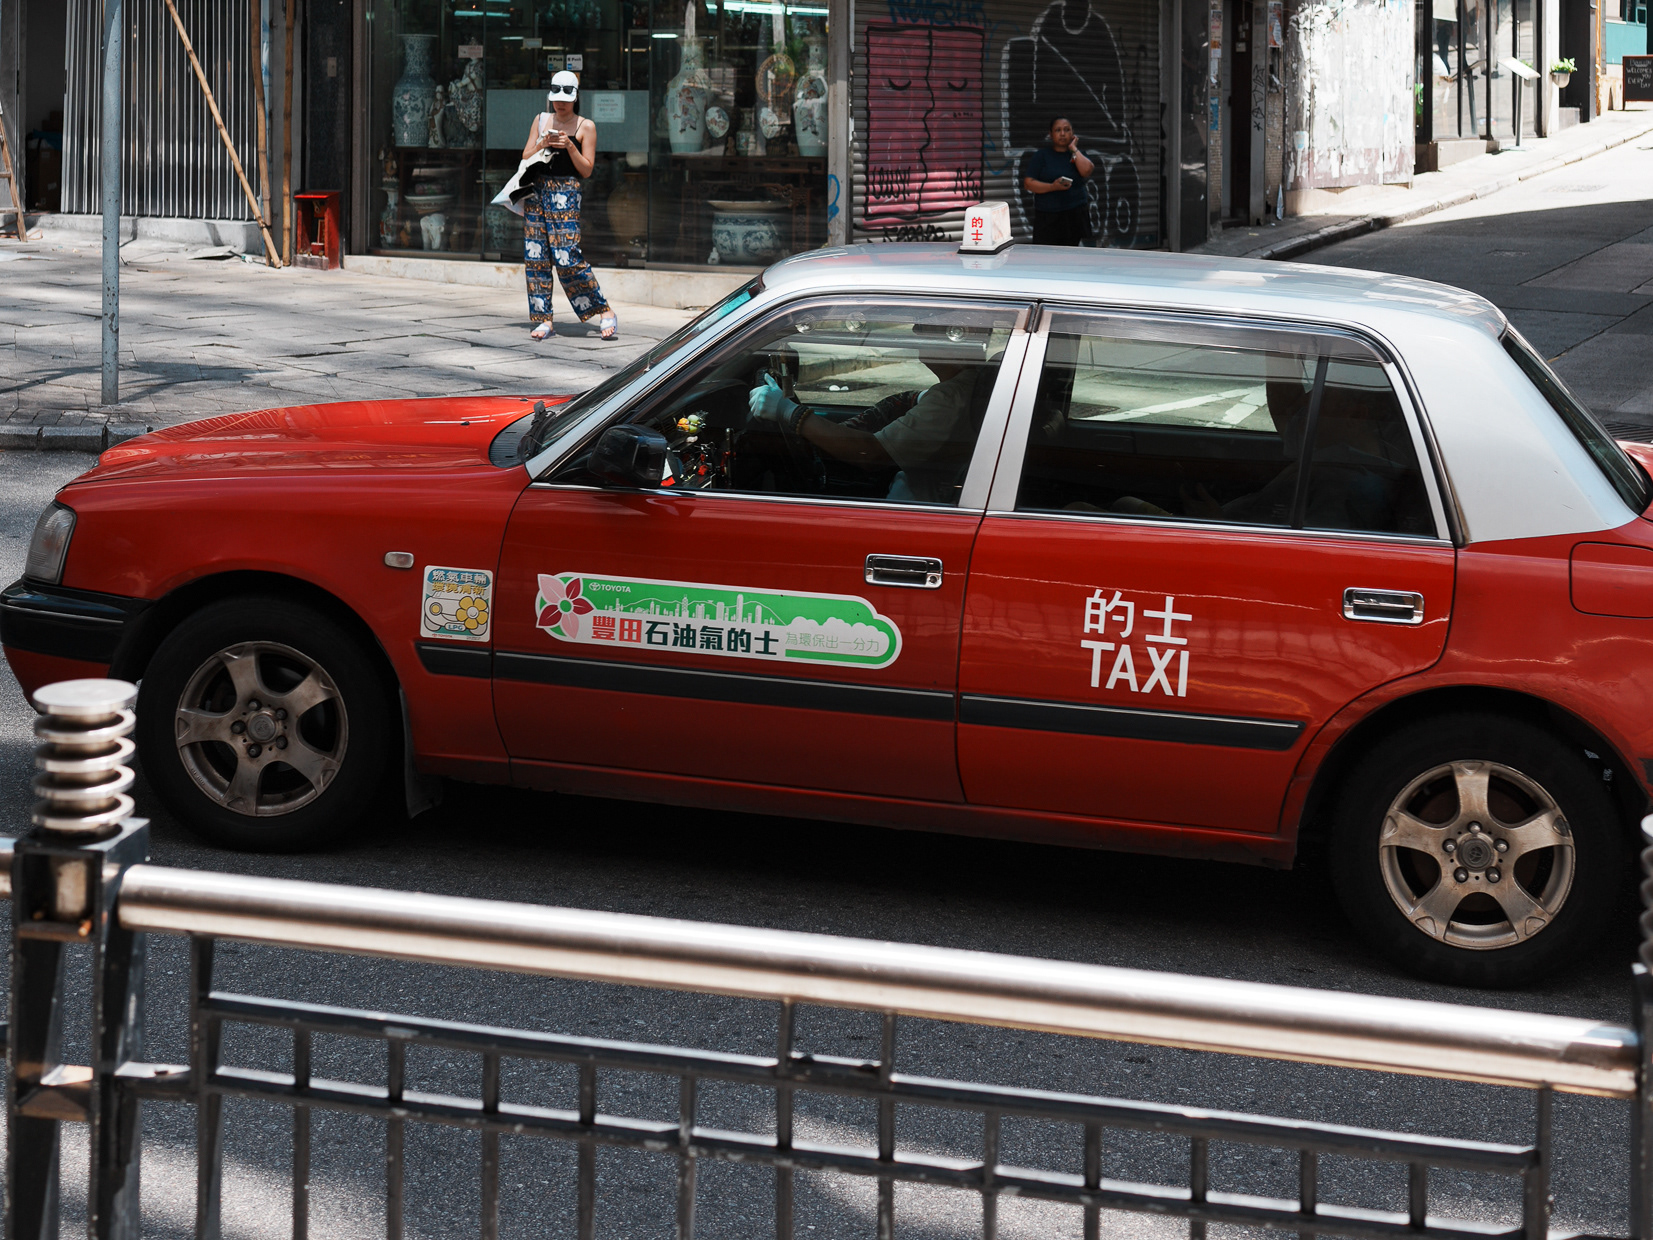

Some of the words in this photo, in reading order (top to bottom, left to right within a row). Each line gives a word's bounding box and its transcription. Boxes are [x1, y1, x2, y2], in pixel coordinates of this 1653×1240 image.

[971, 217, 983, 241] 的士
[601, 583, 631, 593] TOYOTA
[1083, 588, 1193, 645] 的士
[785, 632, 880, 653] 為環保出一分力
[1080, 639, 1190, 698] TAXI
